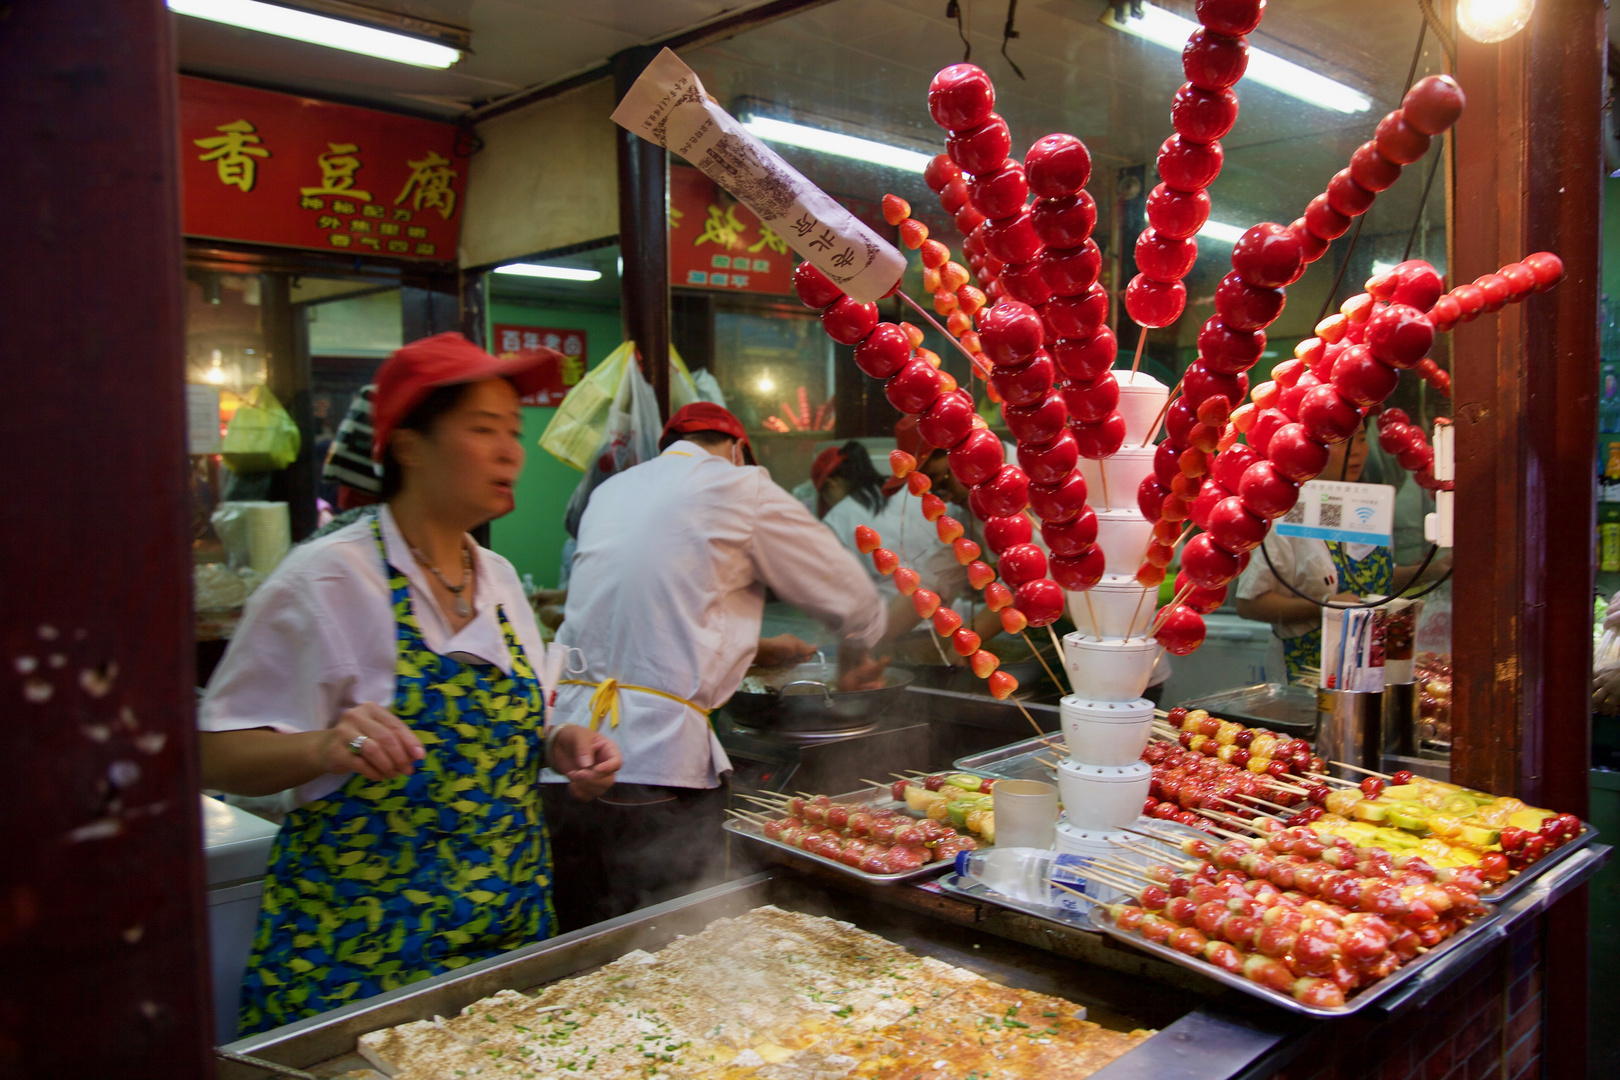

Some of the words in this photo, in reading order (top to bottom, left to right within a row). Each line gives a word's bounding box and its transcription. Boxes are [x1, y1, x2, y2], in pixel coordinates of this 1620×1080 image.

[193, 118, 459, 220] 香豆腐
[790, 212, 857, 270] 老北京
